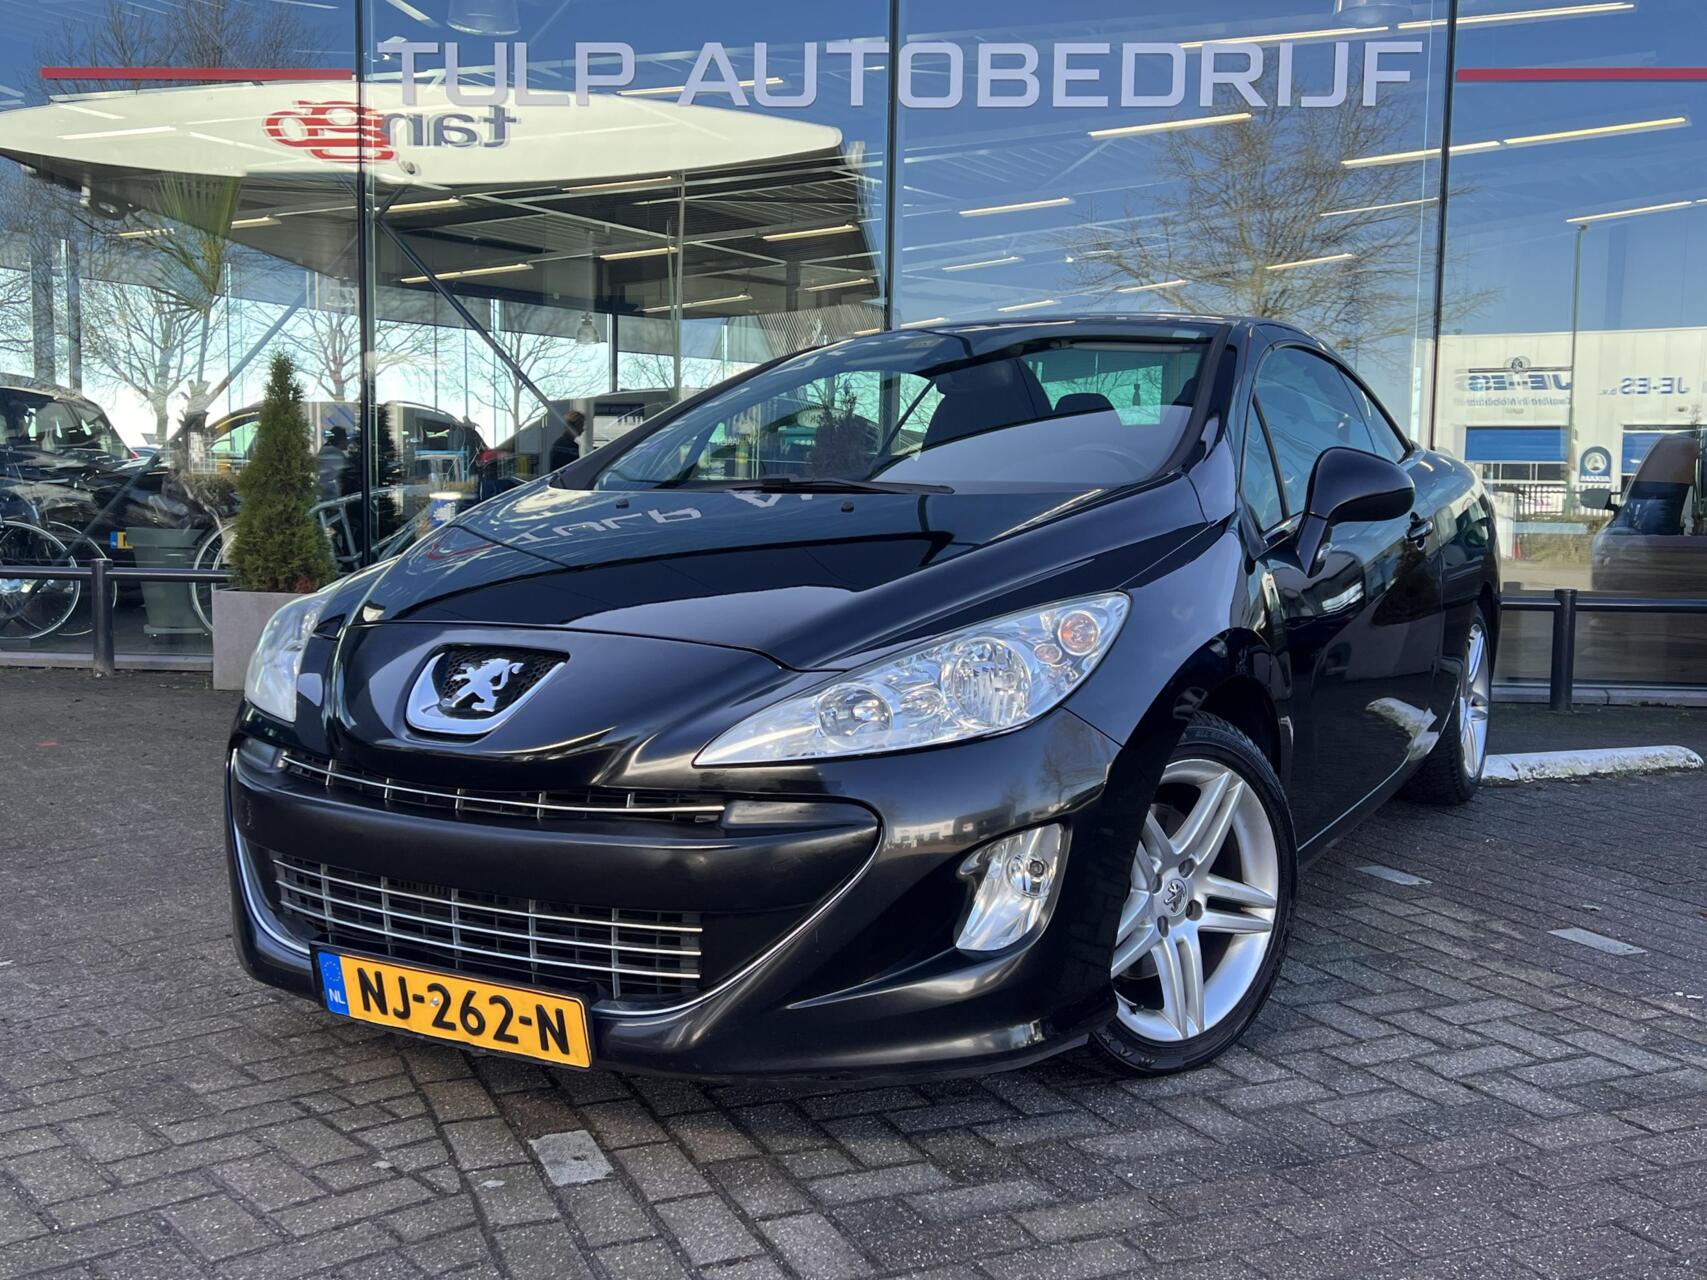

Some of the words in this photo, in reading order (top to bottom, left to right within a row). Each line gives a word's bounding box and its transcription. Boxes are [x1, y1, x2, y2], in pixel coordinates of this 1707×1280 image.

[377, 41, 636, 107] TULP
[677, 41, 1423, 108] AUTOBEDRIJF
[328, 988, 346, 1005] NL
[356, 967, 570, 1055] NJ-262-N
